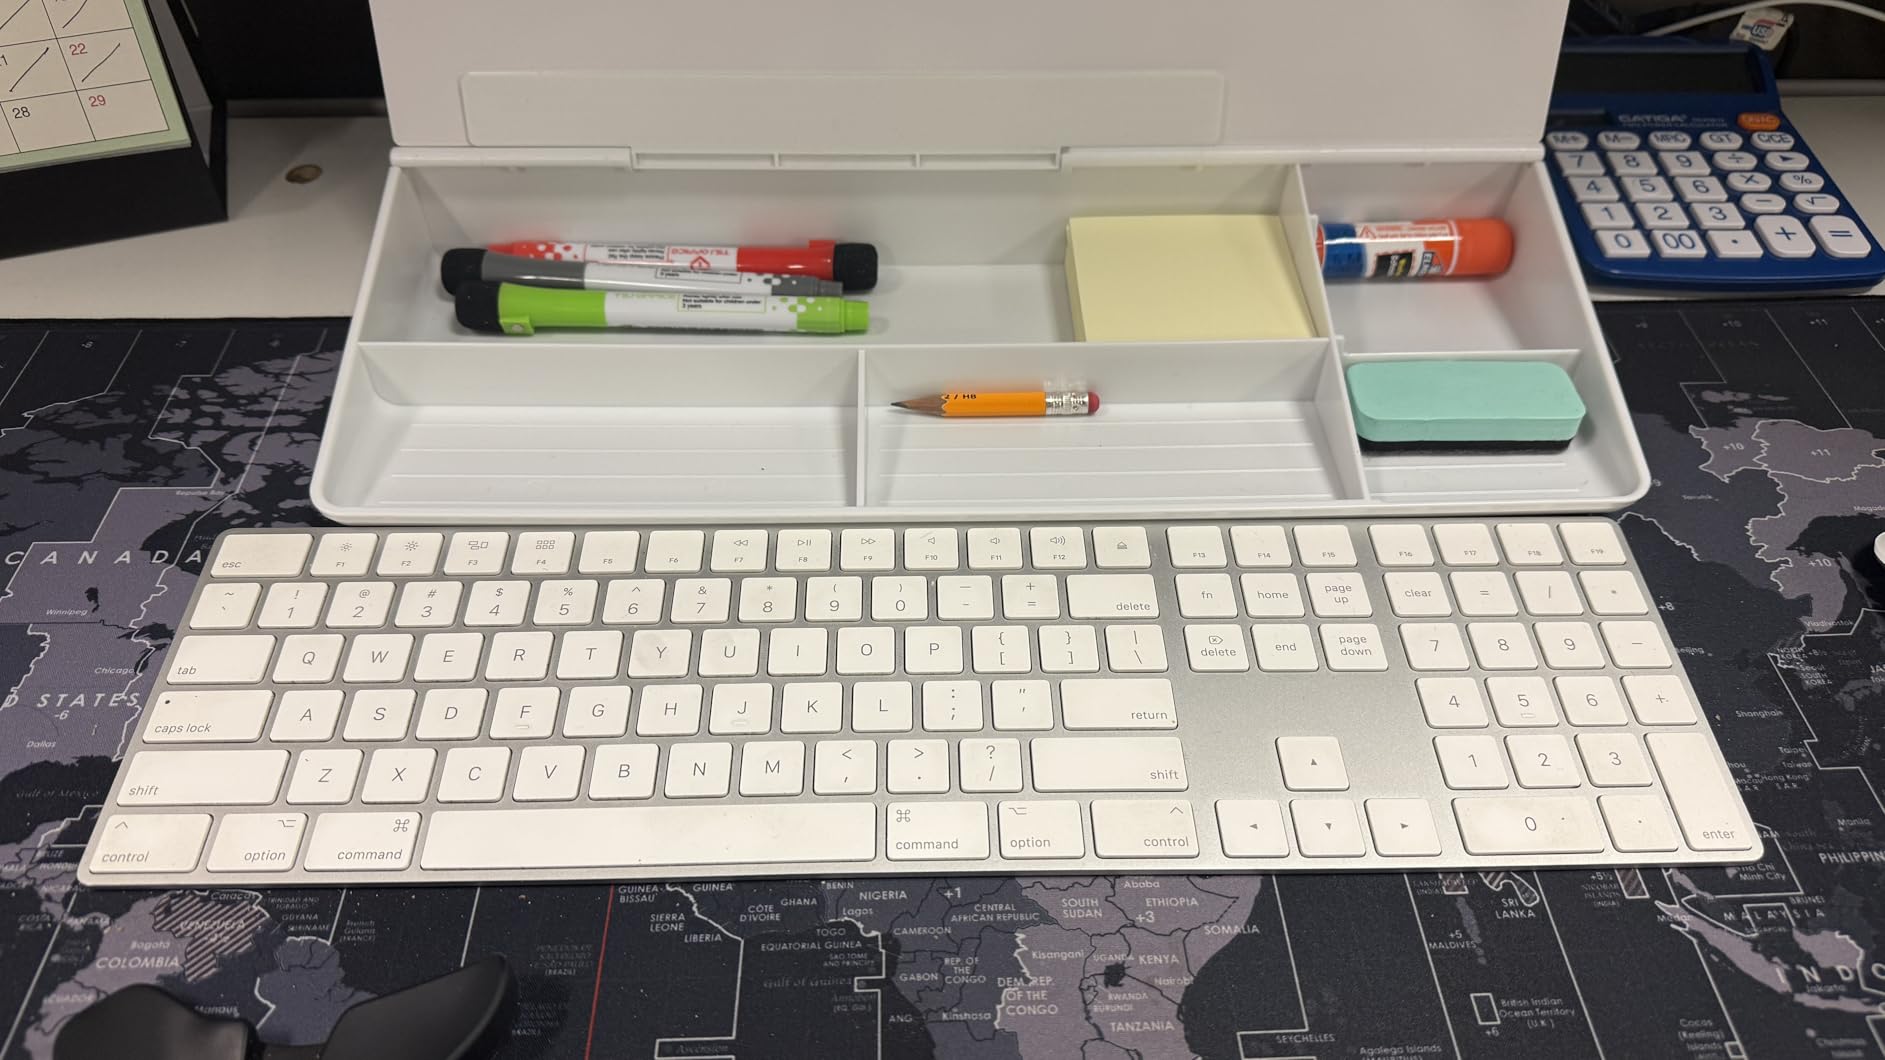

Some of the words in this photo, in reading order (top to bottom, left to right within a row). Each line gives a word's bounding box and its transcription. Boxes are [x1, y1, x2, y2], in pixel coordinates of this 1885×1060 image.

[69, 43, 88, 56] 22
[88, 95, 107, 107] 29
[12, 106, 31, 119] 28
[1709, 133, 1731, 142] GT
[1570, 155, 1583, 167] 7
[1624, 155, 1640, 167] 8
[1676, 155, 1692, 167] 9
[1587, 180, 1600, 192] 4
[1640, 179, 1655, 192] 5
[1693, 180, 1709, 193] 6
[1603, 207, 1613, 219] 1
[1654, 206, 1672, 220] 2
[1709, 207, 1727, 220] 3
[1615, 234, 1631, 248] 0
[1663, 233, 1695, 249] 00
[5, 551, 201, 565] CANADA
[1808, 558, 1832, 567] +10
[221, 561, 242, 569] esc
[1201, 590, 1214, 599] fn
[1257, 591, 1289, 599] home
[1324, 585, 1352, 594] page
[1404, 588, 1432, 598] clear
[762, 600, 773, 613] 8
[829, 599, 840, 612] 9
[895, 599, 906, 612] 0
[1116, 602, 1151, 611] delete
[1333, 596, 1349, 605] up
[1658, 602, 1675, 611] +8
[287, 606, 295, 619] 1
[351, 605, 365, 618] 2
[420, 605, 433, 618] 3
[488, 604, 500, 617] 4
[558, 603, 570, 616] 5
[627, 602, 639, 615] 6
[696, 602, 707, 614] 7
[1275, 642, 1297, 652] end
[1338, 636, 1368, 646] page
[1429, 639, 1439, 652] 7
[1497, 638, 1510, 652] 8
[1563, 638, 1576, 651] 9
[513, 648, 526, 662] R
[585, 647, 598, 661] T
[655, 646, 668, 659] Y
[723, 645, 736, 659] U
[860, 643, 873, 657] O
[929, 642, 940, 656] P
[1200, 647, 1237, 657] delete
[1340, 647, 1372, 656] down
[302, 651, 316, 666] Q
[371, 650, 390, 664] W
[442, 649, 455, 663] E
[177, 665, 197, 675] tab
[37, 693, 140, 707] STATES
[807, 699, 818, 713] K
[879, 698, 889, 712] L
[1448, 695, 1461, 708] 4
[1517, 693, 1530, 708] 5
[1585, 693, 1599, 707] 6
[444, 706, 458, 720] D
[519, 705, 532, 719] F
[591, 703, 605, 718] G
[664, 702, 678, 716] H
[737, 700, 747, 715] J
[54, 710, 69, 720] -6
[299, 708, 312, 722] A
[373, 707, 387, 721] S
[1131, 711, 1168, 720] return
[154, 725, 184, 735] caps
[185, 722, 212, 733] lock
[1468, 754, 1478, 768] 1
[1537, 752, 1552, 767] 2
[1608, 751, 1622, 766] 3
[544, 764, 558, 780] V
[617, 763, 631, 779] B
[692, 762, 707, 777] N
[765, 759, 780, 774] M
[317, 768, 333, 783] Z
[391, 767, 407, 782] X
[468, 766, 482, 782] C
[1150, 769, 1180, 780] shift
[128, 785, 159, 796] shift
[1524, 816, 1537, 832] 0
[1702, 829, 1735, 840] enter
[895, 838, 959, 850] command
[1010, 836, 1051, 850] option
[1143, 835, 1189, 847] control
[101, 850, 150, 863] control
[244, 849, 286, 863] option
[337, 848, 403, 860] command
[1739, 873, 1764, 881] Minh
[1766, 872, 1786, 881] City
[693, 883, 733, 892] GUINEA
[826, 881, 854, 890] BENIN
[1124, 880, 1160, 889] Ababa
[859, 890, 908, 900] NIGERIA
[944, 887, 961, 898] +1
[620, 895, 655, 904] BISSAU
[781, 897, 817, 906] GHANA
[1062, 898, 1099, 908] SOUTH
[1145, 897, 1199, 907] ETHIOPIA
[1501, 898, 1519, 908] SRI
[843, 907, 873, 916] Lagos
[974, 904, 1016, 912] CENTRAL
[1063, 909, 1103, 919] SUDAN
[1495, 909, 1536, 919] LANKA
[650, 913, 685, 922] SIERRA
[951, 914, 993, 922] AFRICAN
[996, 912, 1040, 921] REPUBLIC
[1136, 911, 1155, 923] +3
[1723, 909, 1825, 921] MALAYSIA
[650, 923, 684, 932] LEONE
[816, 928, 846, 936] TOGO
[893, 926, 951, 936] CAMEROON
[1204, 925, 1260, 935] SOMALIA
[684, 934, 722, 943] LIBERIA
[1449, 930, 1462, 939] +5
[761, 942, 821, 951] EQUATORIAL
[825, 941, 862, 949] GUINEA
[1429, 941, 1477, 950] MALDIVES
[1032, 950, 1084, 960] Kisangani
[1093, 953, 1135, 961] UGANDA
[1139, 954, 1180, 965] KENYA
[96, 956, 180, 968] COLOMBIA
[900, 972, 938, 981] GABON
[953, 966, 971, 975] THE
[945, 975, 986, 984] CONGO
[1006, 990, 1023, 1001] OF
[1027, 990, 1048, 1001] THE
[1006, 1004, 1059, 1015] CONGO
[942, 1011, 991, 1021] Kinshasa
[1110, 1021, 1175, 1032] TANZANIA
[1276, 1033, 1336, 1043] SEYCHELLES
